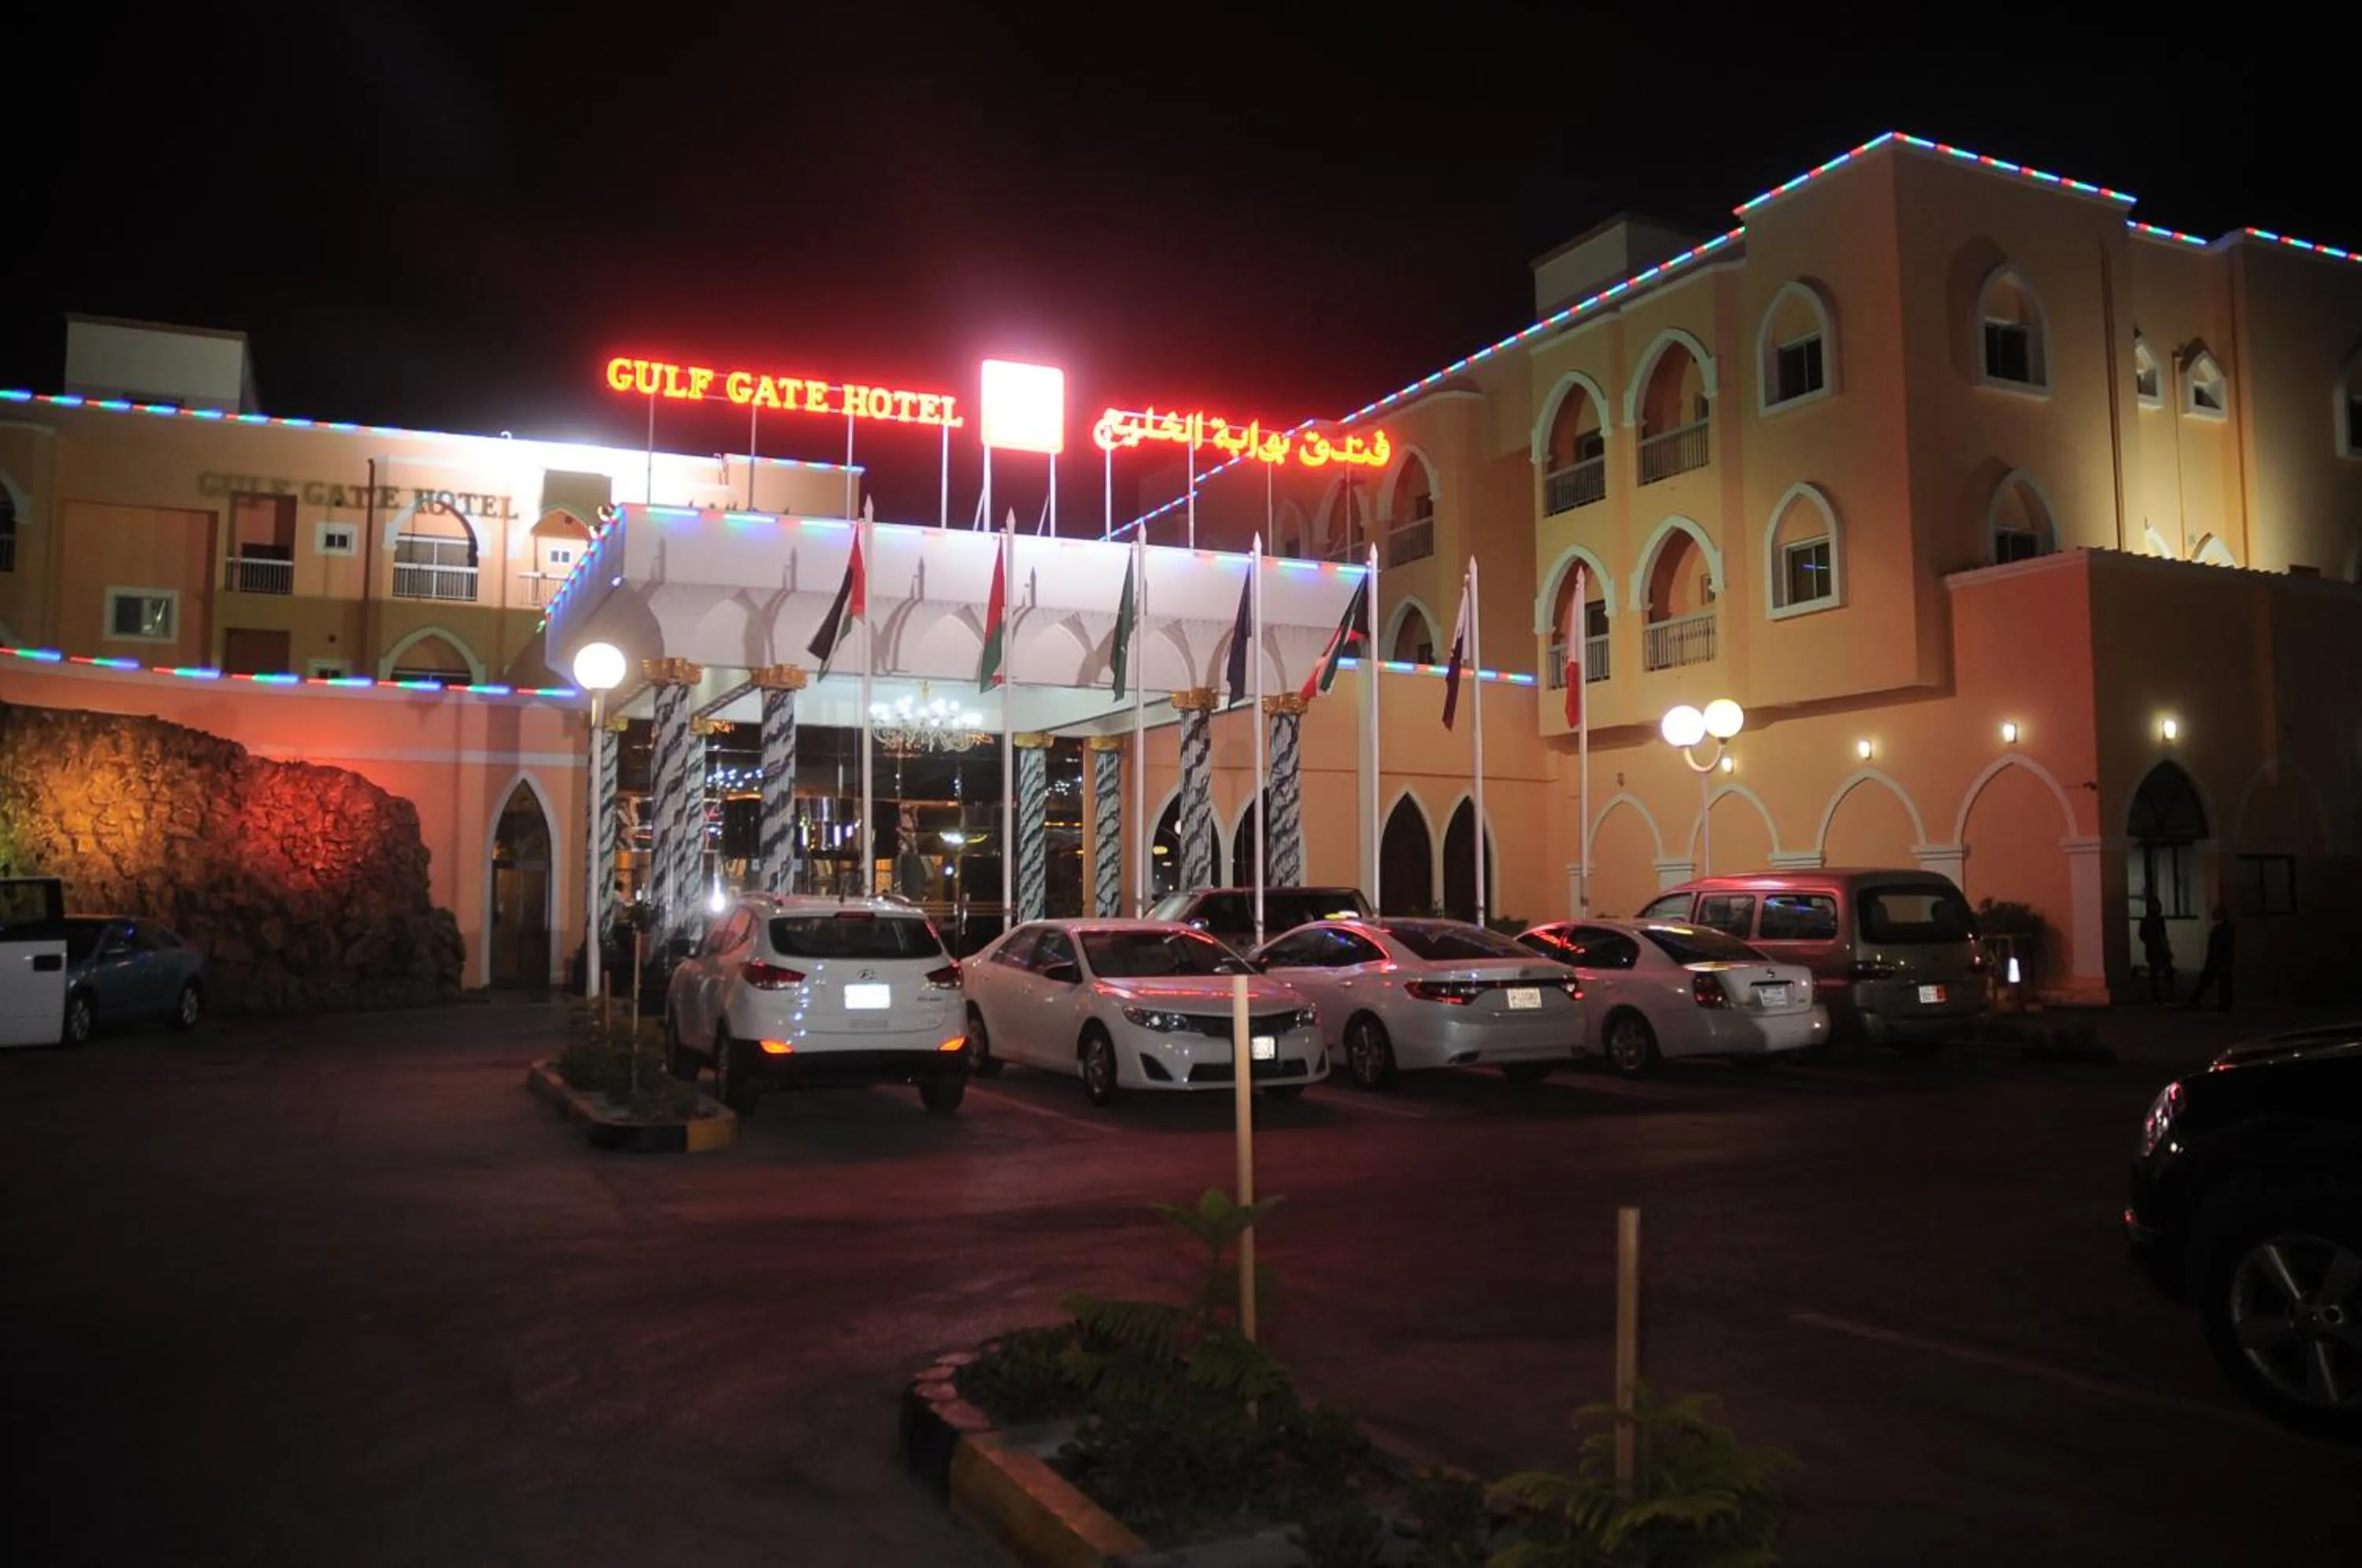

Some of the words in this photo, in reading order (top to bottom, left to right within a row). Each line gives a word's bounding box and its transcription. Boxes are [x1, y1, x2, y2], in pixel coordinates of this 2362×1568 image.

[607, 357, 713, 400] GULF
[726, 372, 829, 413] GATE
[842, 384, 963, 427] HOTEL
[1093, 405, 1203, 450] الخليج
[1212, 417, 1291, 465] بوابة
[1298, 430, 1390, 467] فندق
[302, 481, 399, 510] GATE
[412, 487, 520, 520] HOTEL
